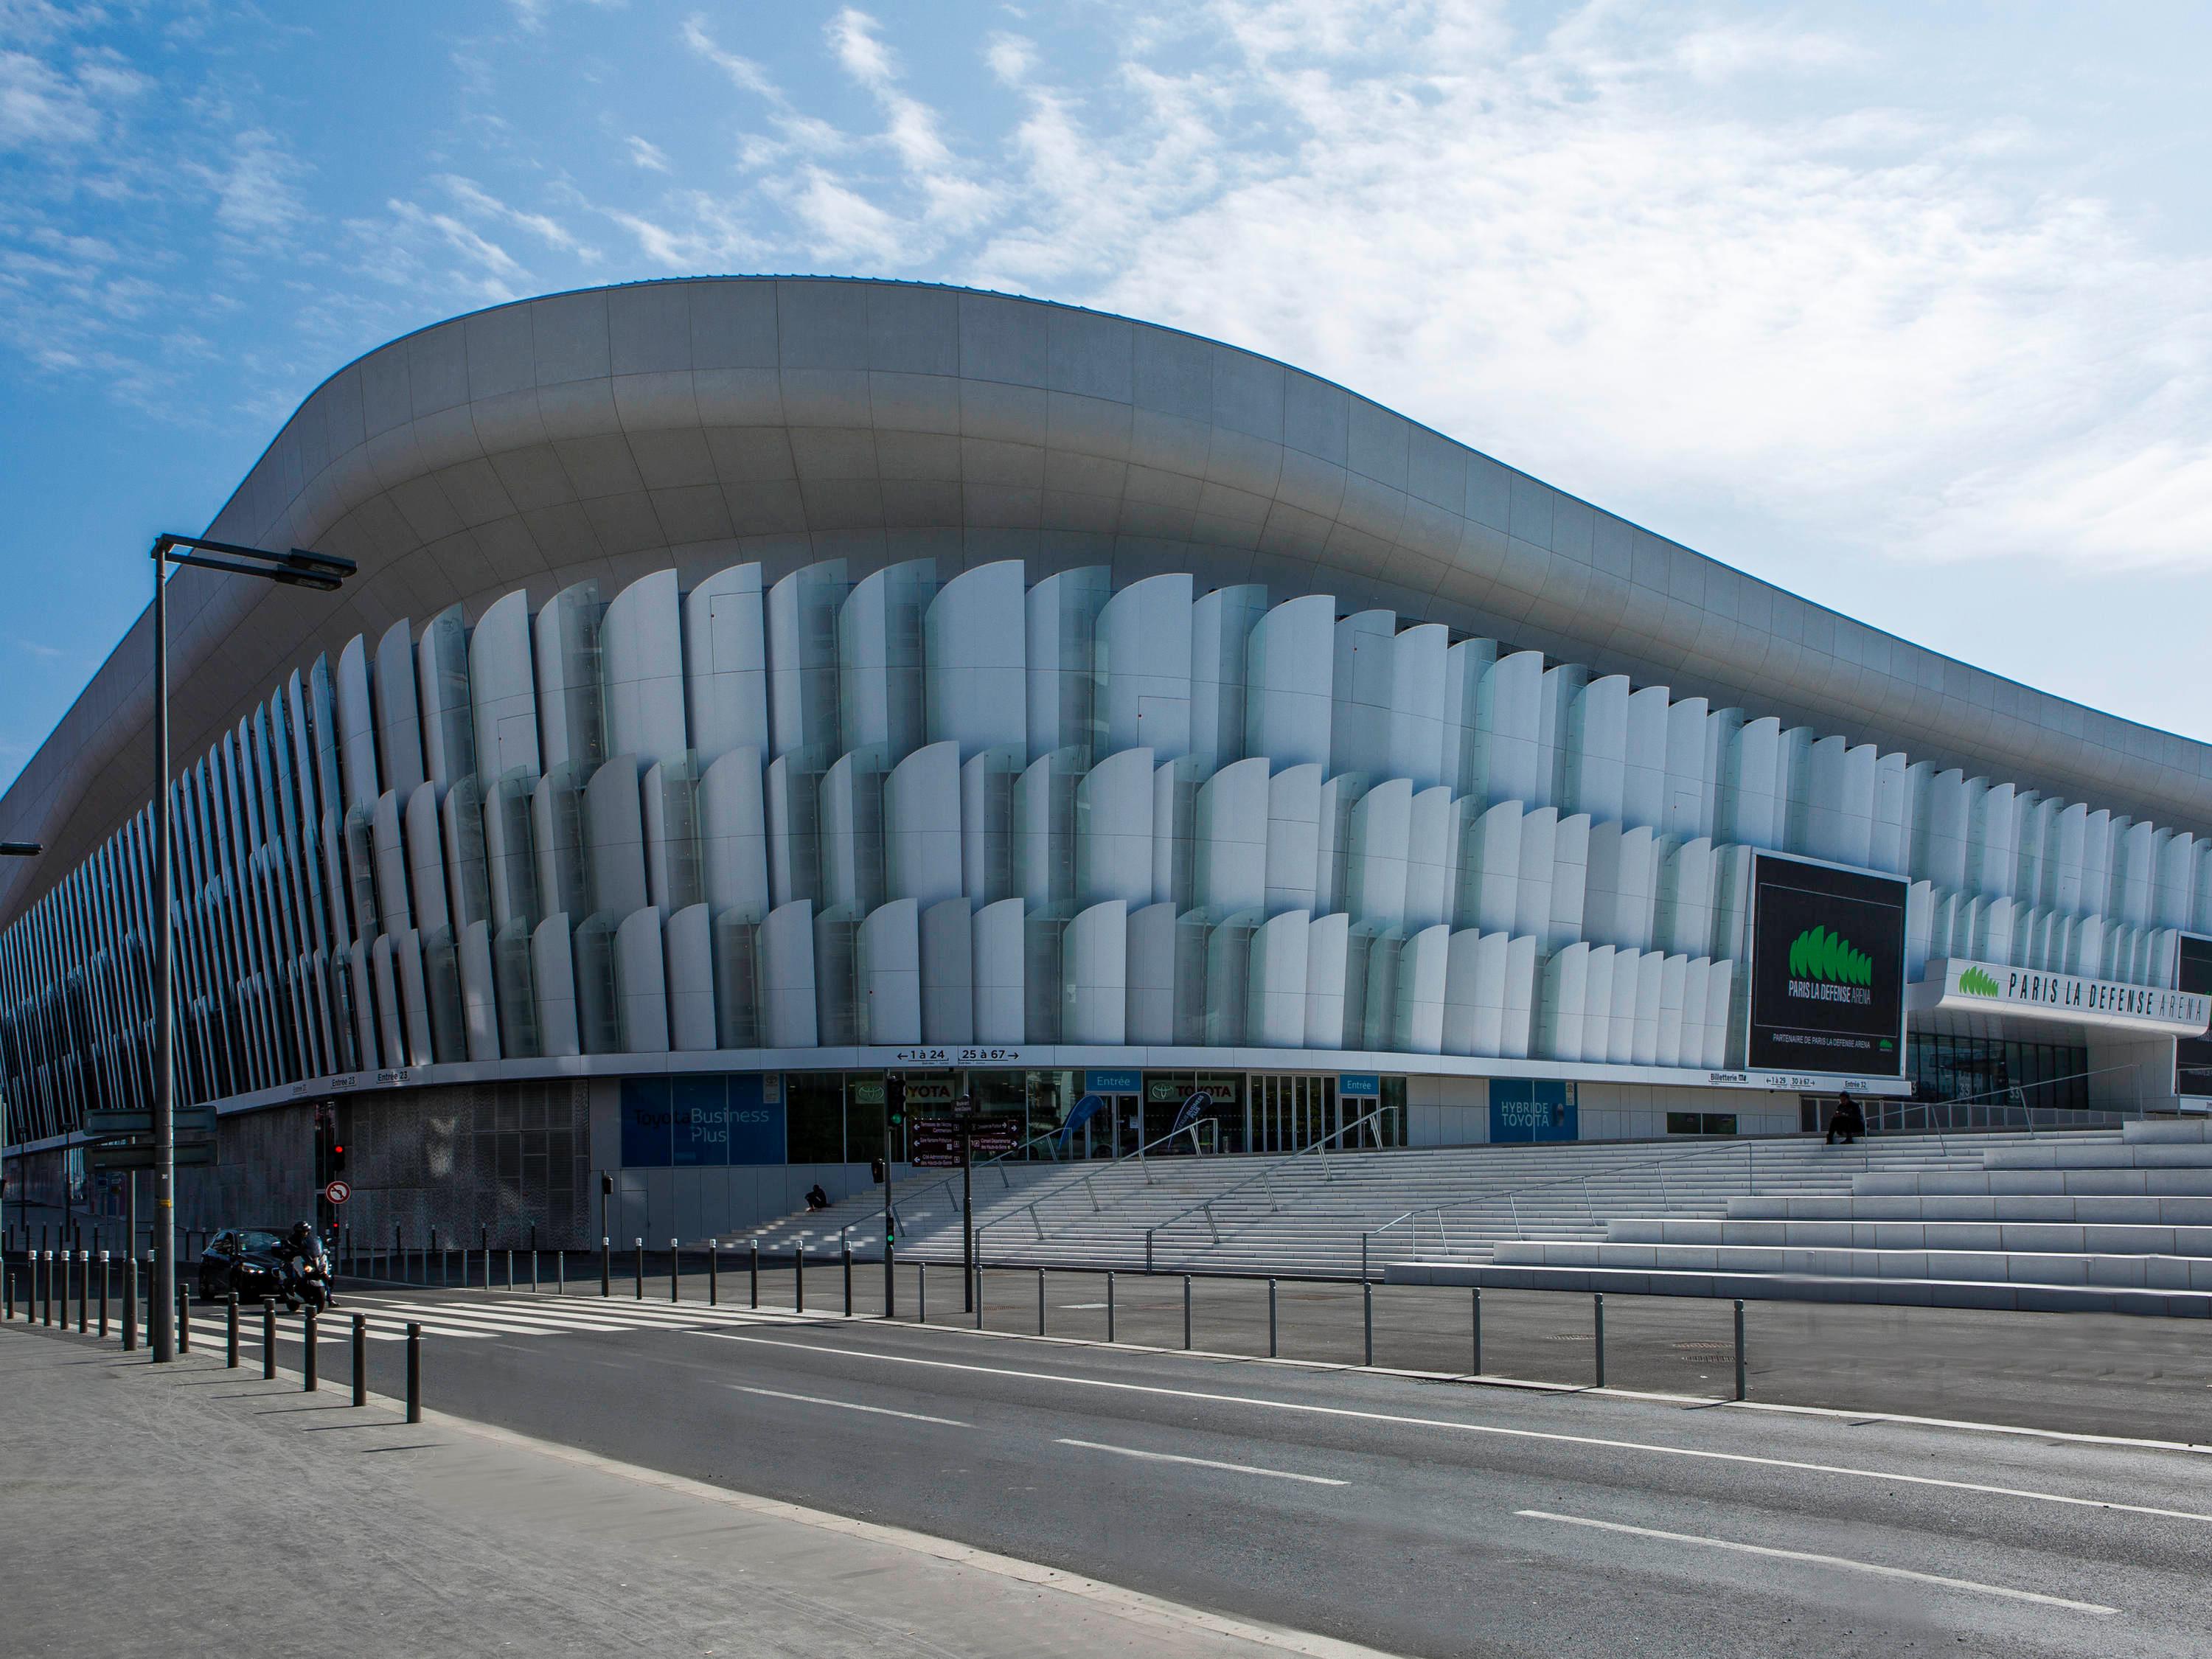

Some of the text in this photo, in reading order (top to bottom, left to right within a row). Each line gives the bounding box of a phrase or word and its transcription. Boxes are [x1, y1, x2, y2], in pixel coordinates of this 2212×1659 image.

[1788, 980, 1871, 1005] PARIS LA DEFENSE ARENA
[2008, 973, 2202, 1021] PARIS LA DEFENSE ARENA
[1773, 1034, 1871, 1048] PARTENAIRE DE PARIS LA DEFENSE ARENA
[911, 1049, 945, 1059] 1 à 24
[962, 1049, 1006, 1059] 25 à 67
[348, 1077, 355, 1085] 23
[378, 1071, 408, 1082] Entrée 23
[1096, 1076, 1130, 1086] Entrée
[1710, 1073, 1737, 1082] Billetterie
[1347, 1079, 1372, 1090] Entrée
[1501, 1101, 1549, 1114] HYBRIDE
[691, 1107, 770, 1124] Business
[1501, 1114, 1550, 1127] TOYOTA
[692, 1127, 727, 1143] Plus
